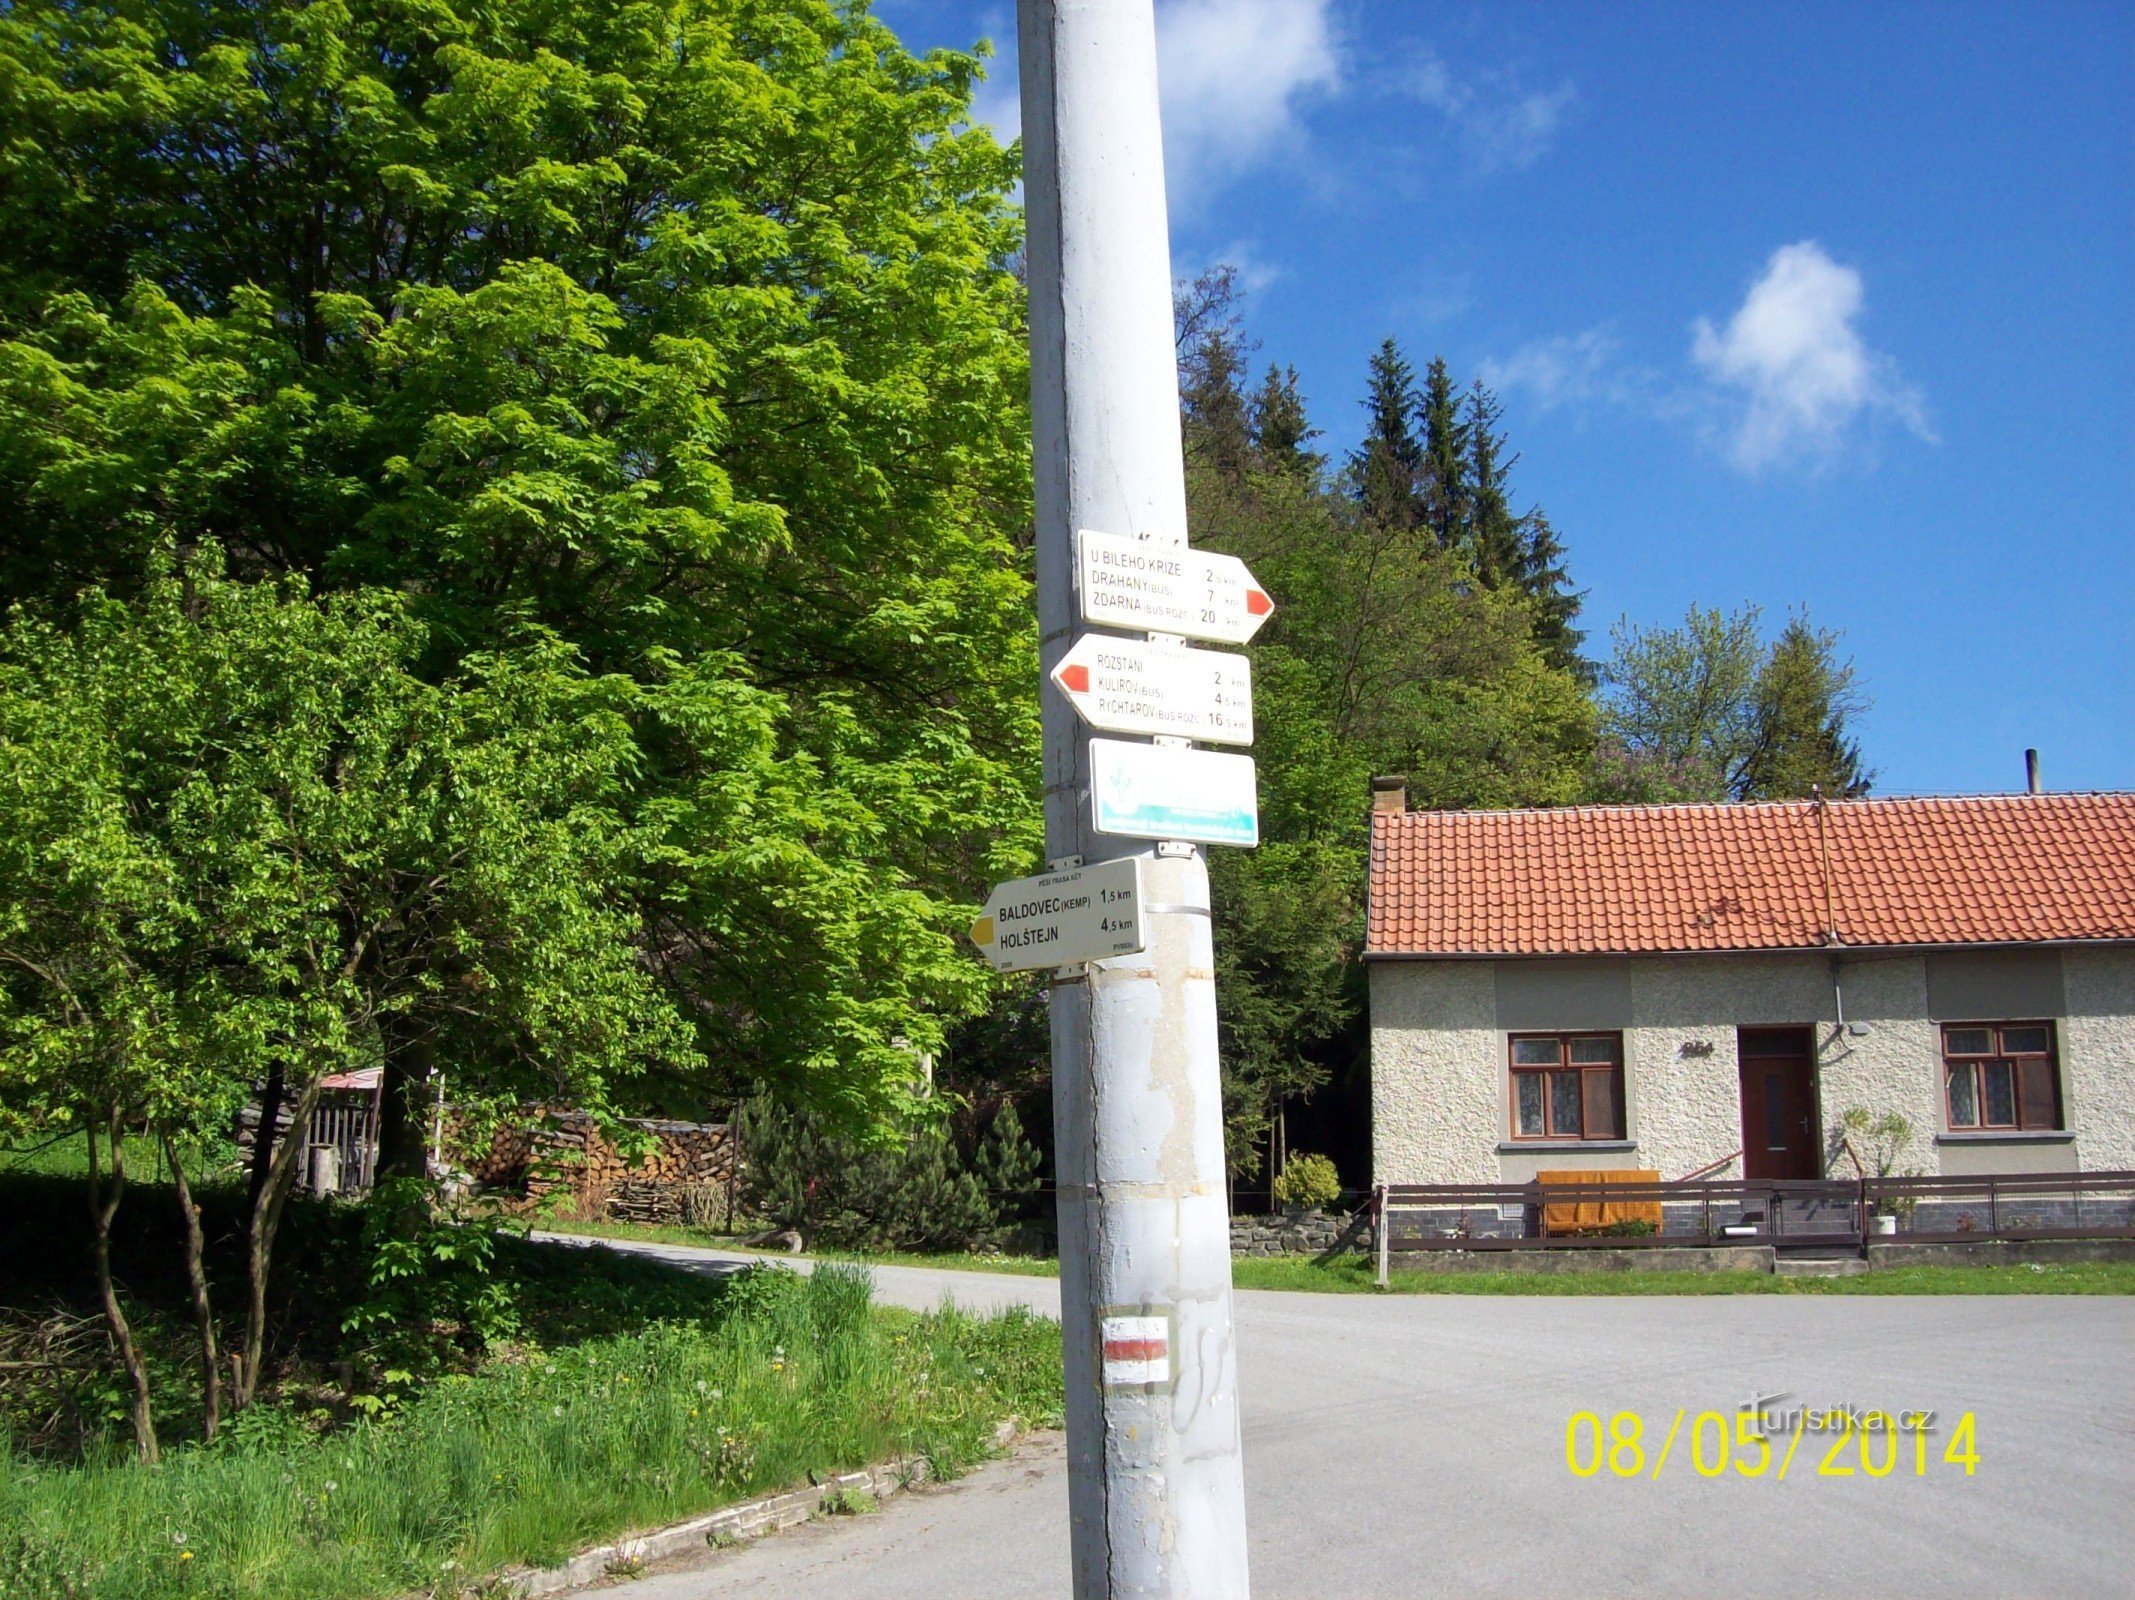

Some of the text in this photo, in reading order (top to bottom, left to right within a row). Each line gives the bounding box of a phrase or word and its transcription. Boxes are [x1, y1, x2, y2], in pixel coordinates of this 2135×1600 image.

[1091, 549, 1099, 563] U
[1207, 589, 1214, 602] 7
[1201, 609, 1216, 624] 20
[1214, 671, 1222, 686] 2
[1100, 888, 1116, 904] 1,5
[1117, 889, 1131, 901] km
[1000, 917, 1133, 950] HOLŠTEJN 4,5 km
